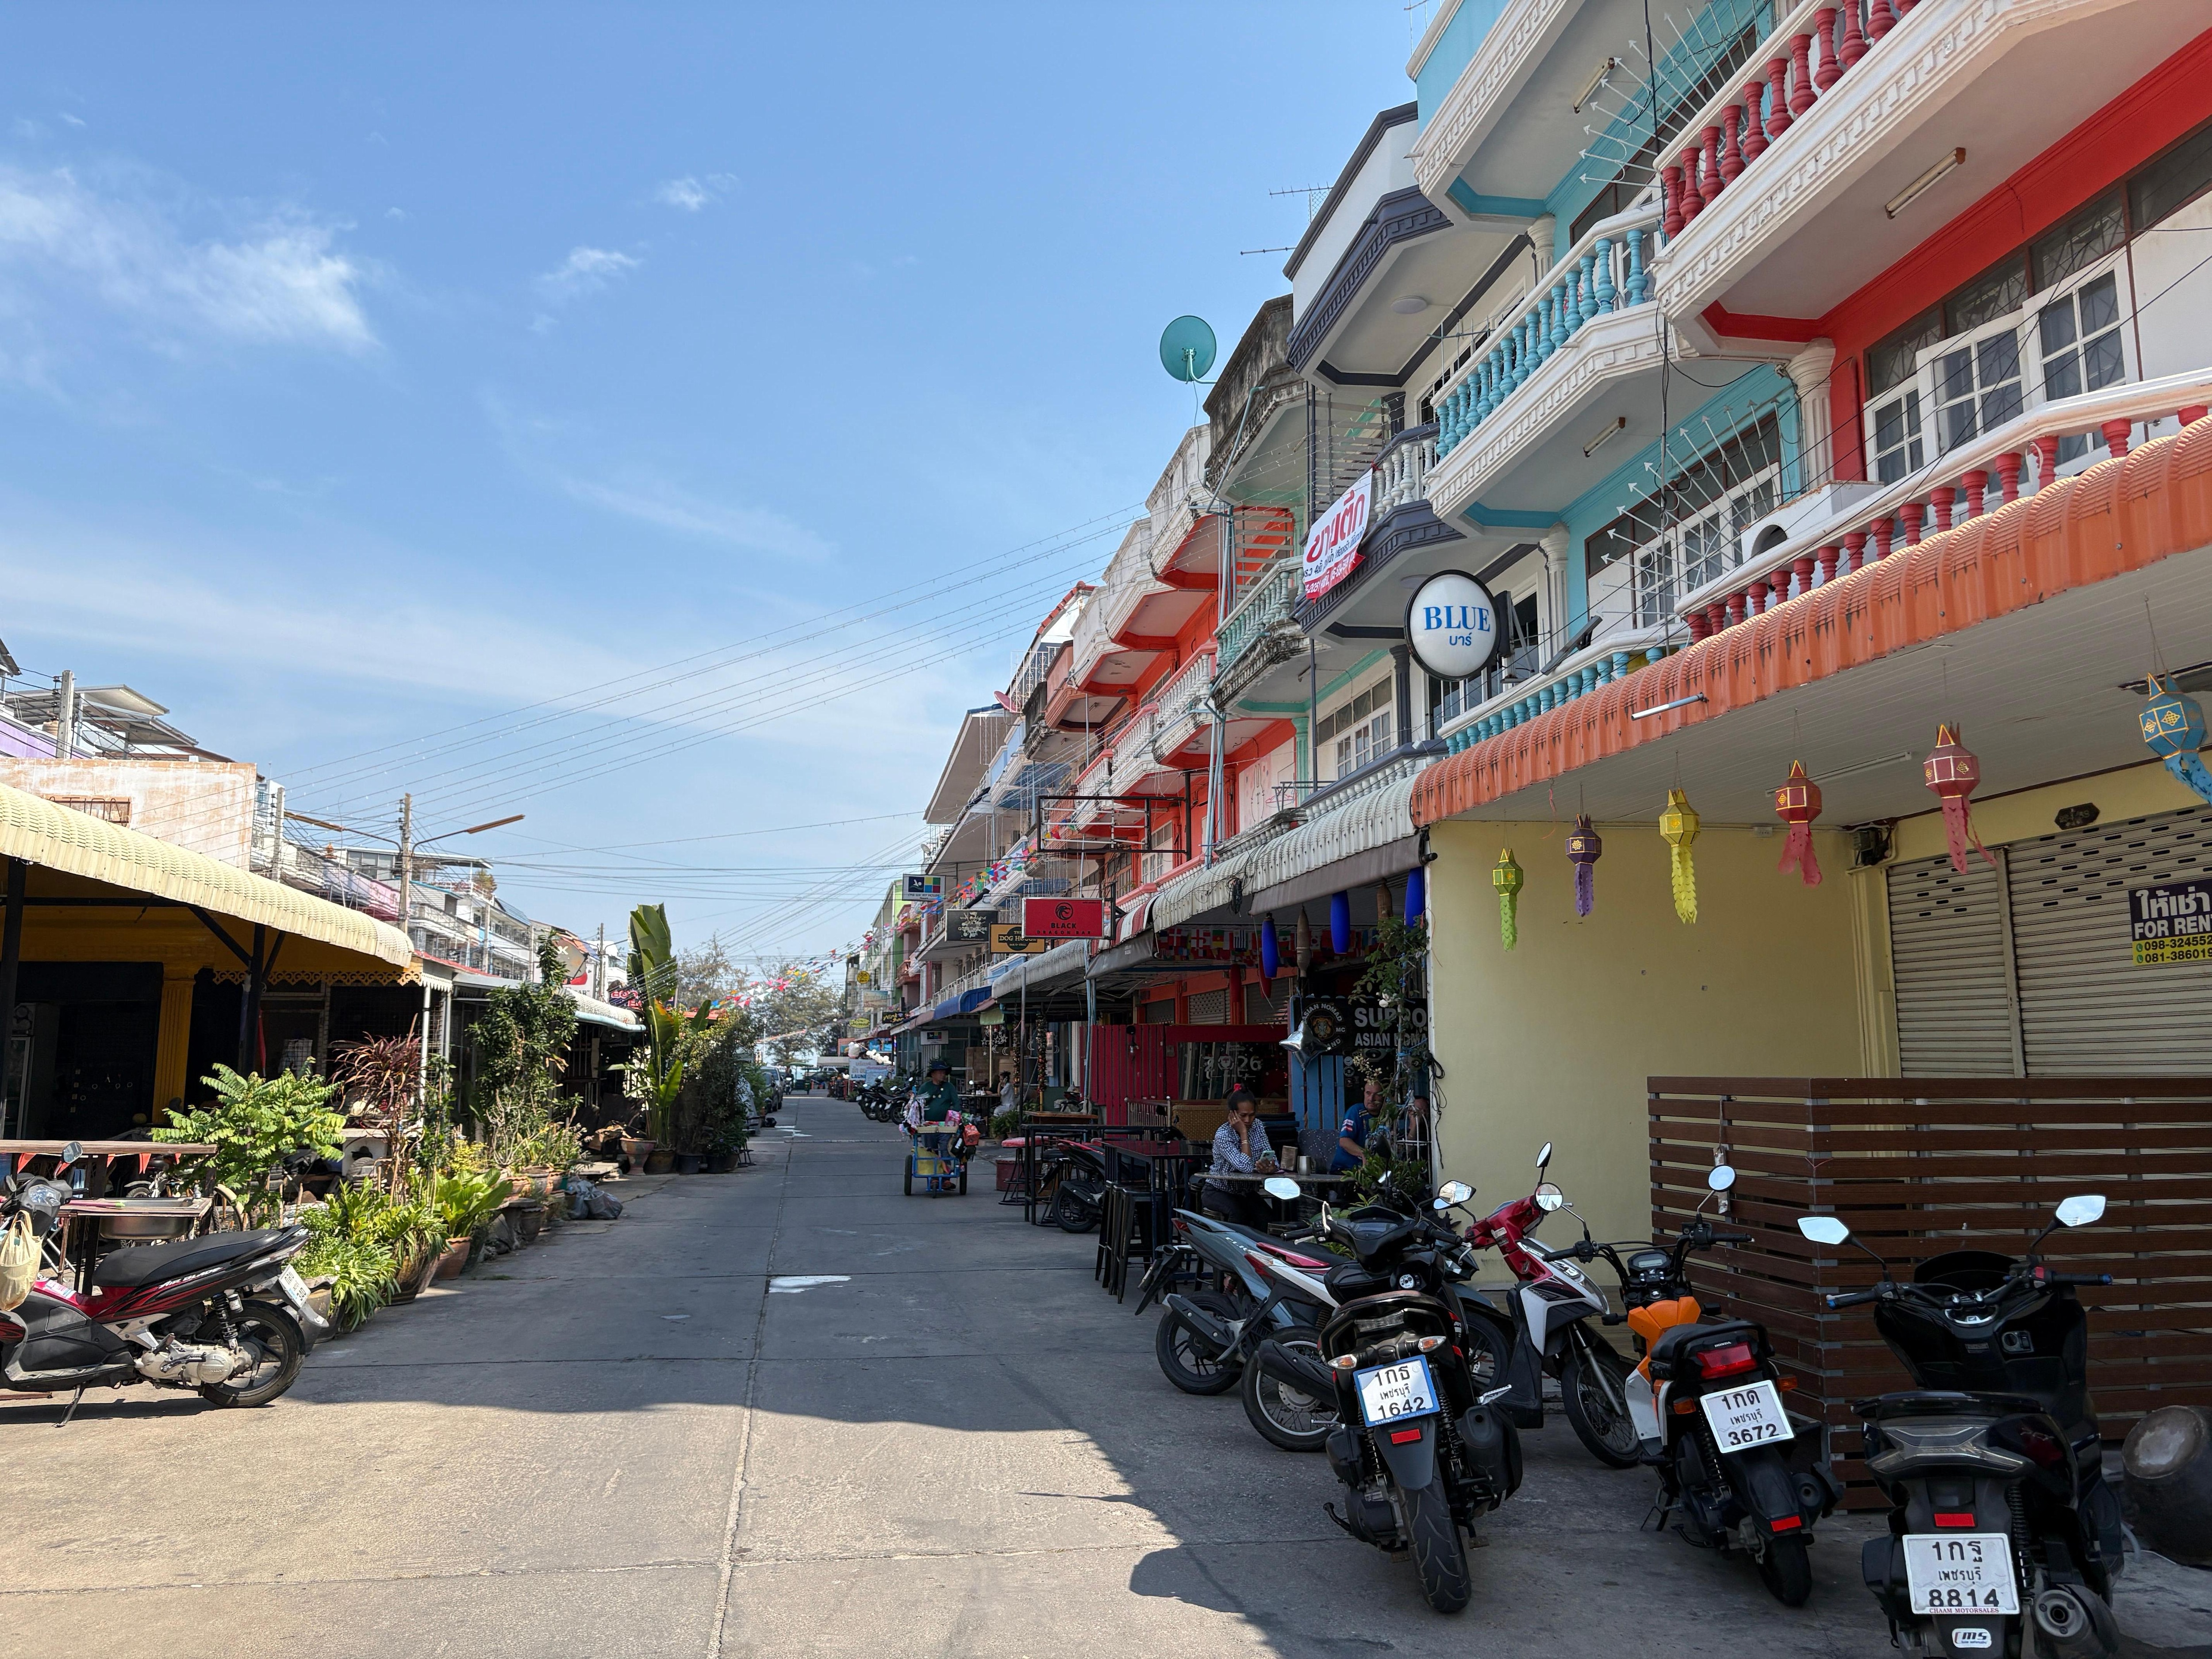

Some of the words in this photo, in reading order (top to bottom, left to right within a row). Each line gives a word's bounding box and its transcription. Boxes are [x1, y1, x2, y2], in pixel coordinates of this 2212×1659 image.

[1306, 490, 1365, 563] ขายตึก
[1423, 606, 1490, 632] BLUE
[1449, 632, 1472, 646] บาร์
[2136, 886, 2210, 919] ให้เช่า
[2134, 920, 2169, 939] FOR
[2174, 914, 2212, 935] REN
[1302, 1003, 1319, 1020] ASIAN
[1321, 1003, 1342, 1022] NOMAD
[1355, 1033, 1390, 1046] ASIAN
[158, 1279, 181, 1289] AIR
[182, 1267, 223, 1281] BLADE
[296, 1287, 307, 1301] 340
[1375, 1366, 1410, 1386] 1กธ
[1380, 1383, 1410, 1400] เพชรบุรี
[1721, 1390, 1760, 1410] 1กด
[1378, 1397, 1426, 1419] 1642
[1730, 1409, 1763, 1425] เพชรบุรี
[1728, 1423, 1779, 1446] 3672
[1932, 1541, 1982, 1562] 1กฐ
[1938, 1567, 1981, 1584] เพชรบุรี
[1929, 1589, 2000, 1607] 8814
